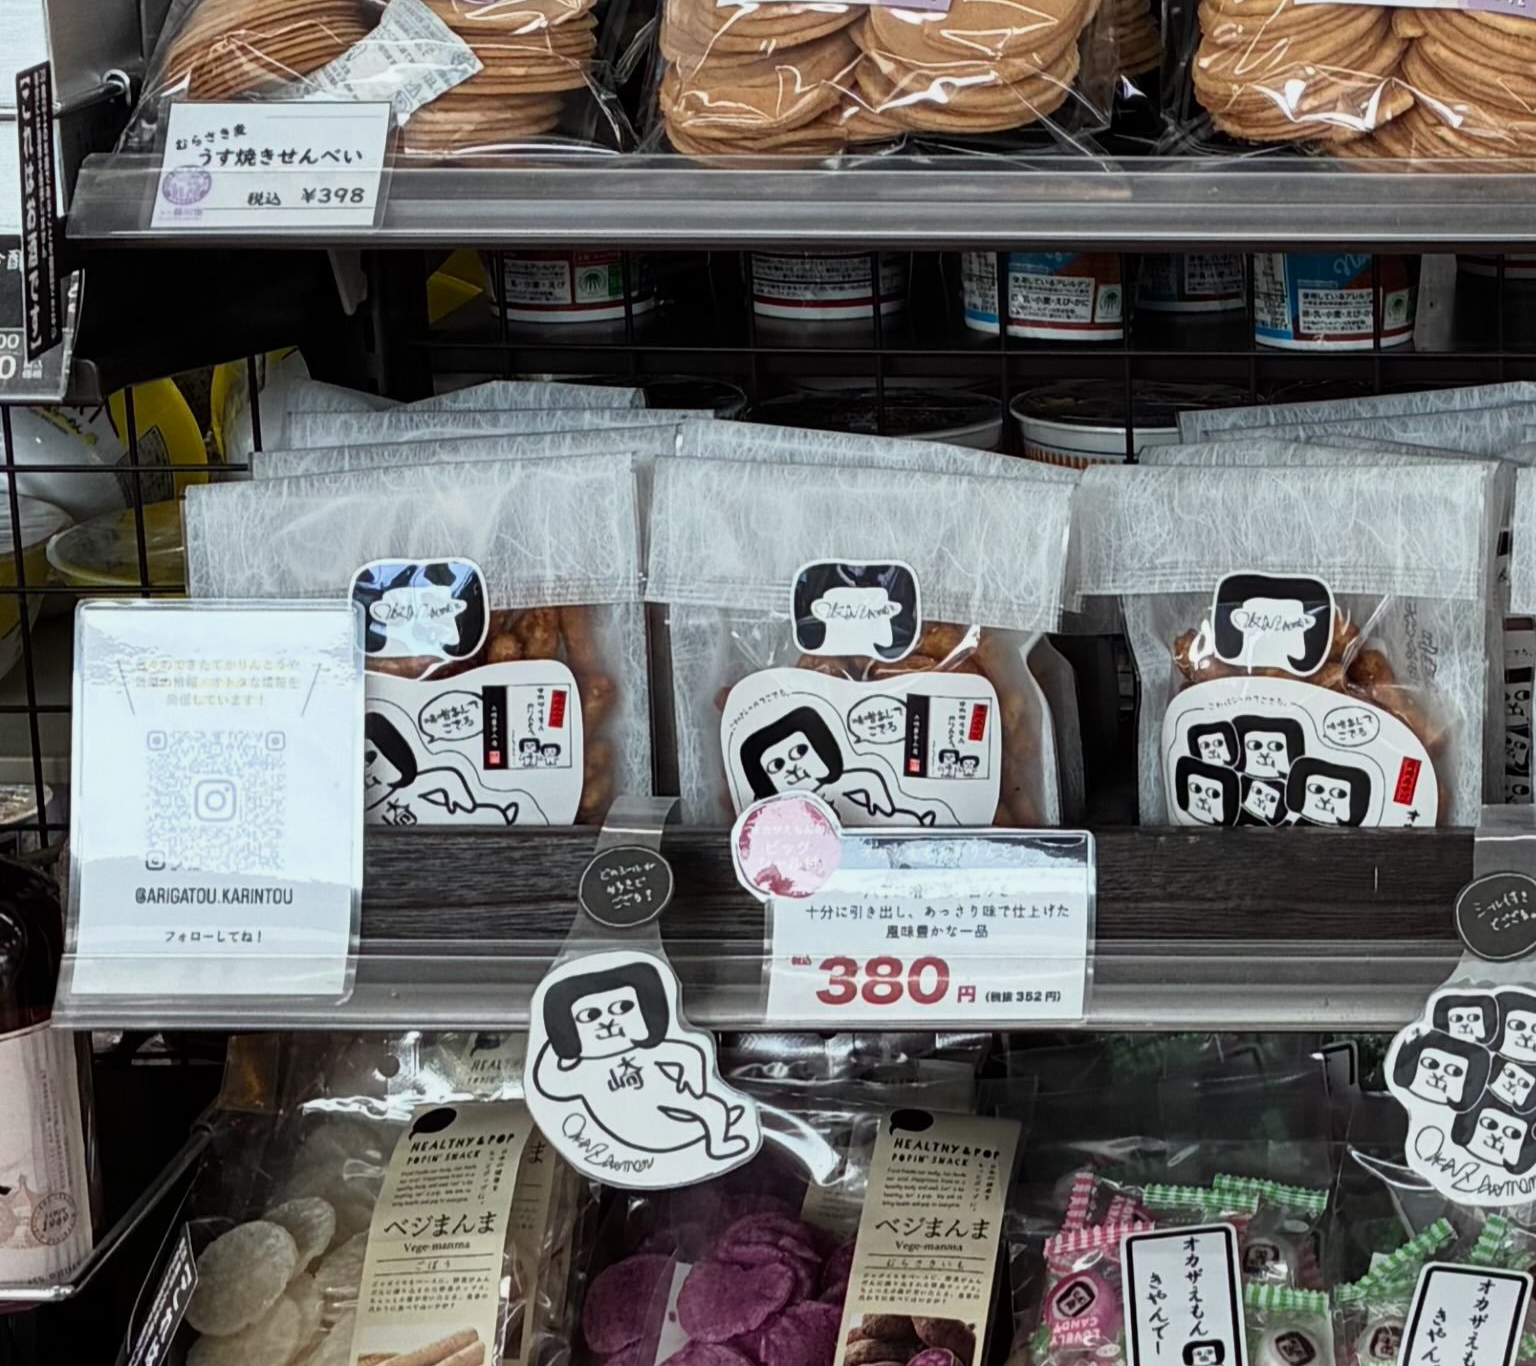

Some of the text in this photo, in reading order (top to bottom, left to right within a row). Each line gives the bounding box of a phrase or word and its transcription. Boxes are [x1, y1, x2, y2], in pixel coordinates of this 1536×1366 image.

[176, 123, 248, 152] むらさき麦
[199, 147, 363, 167] うす焼きせんべい
[247, 187, 366, 207] 税込 ¥398
[135, 886, 294, 906] @ARIGATOU.KARINTOU
[806, 904, 1070, 920] 十分に引き出し、あっさり味で仕上げた
[885, 924, 990, 940] 風味豊かな一品
[816, 955, 977, 1007] 380円
[383, 1210, 498, 1238] ベジまんま
[875, 1217, 991, 1241] ベジまんま
[1182, 1237, 1209, 1337] オカザえもん
